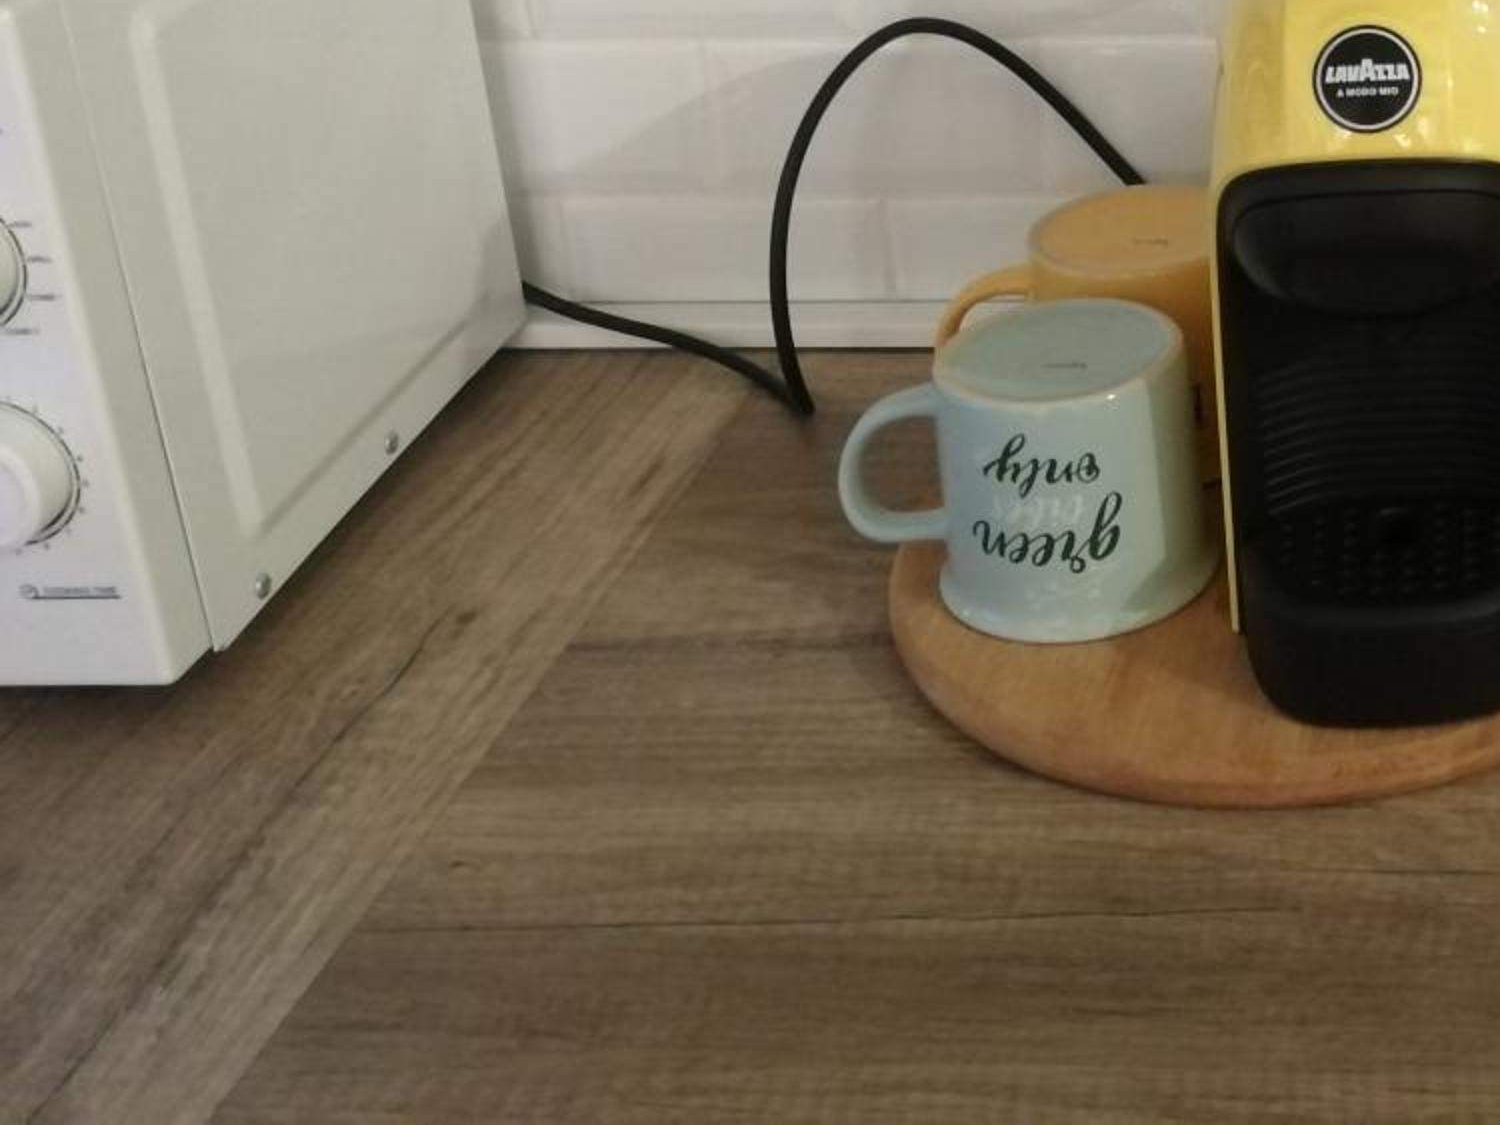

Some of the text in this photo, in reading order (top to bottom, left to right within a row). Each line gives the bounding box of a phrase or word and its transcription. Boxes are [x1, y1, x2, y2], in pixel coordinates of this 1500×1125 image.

[1324, 57, 1411, 84] LAVAZZA
[983, 432, 1101, 500] only
[972, 490, 1123, 574] green
